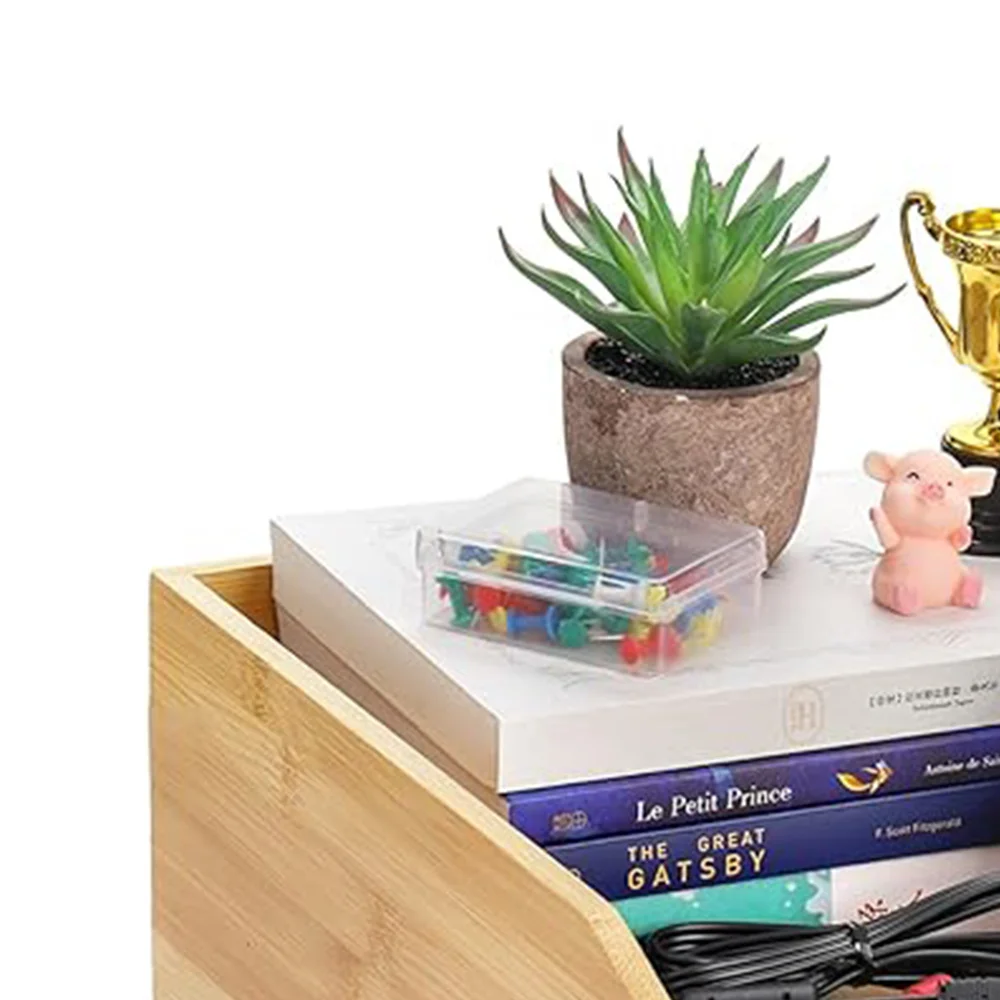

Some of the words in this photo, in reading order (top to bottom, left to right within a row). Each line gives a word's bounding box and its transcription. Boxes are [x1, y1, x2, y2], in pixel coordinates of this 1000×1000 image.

[966, 757, 981, 770] de
[637, 800, 664, 822] Le
[670, 791, 719, 818] Petit
[726, 785, 793, 810] Prince
[627, 842, 669, 863] THE
[696, 827, 766, 853] GREAT
[627, 849, 766, 891] GATSBY
